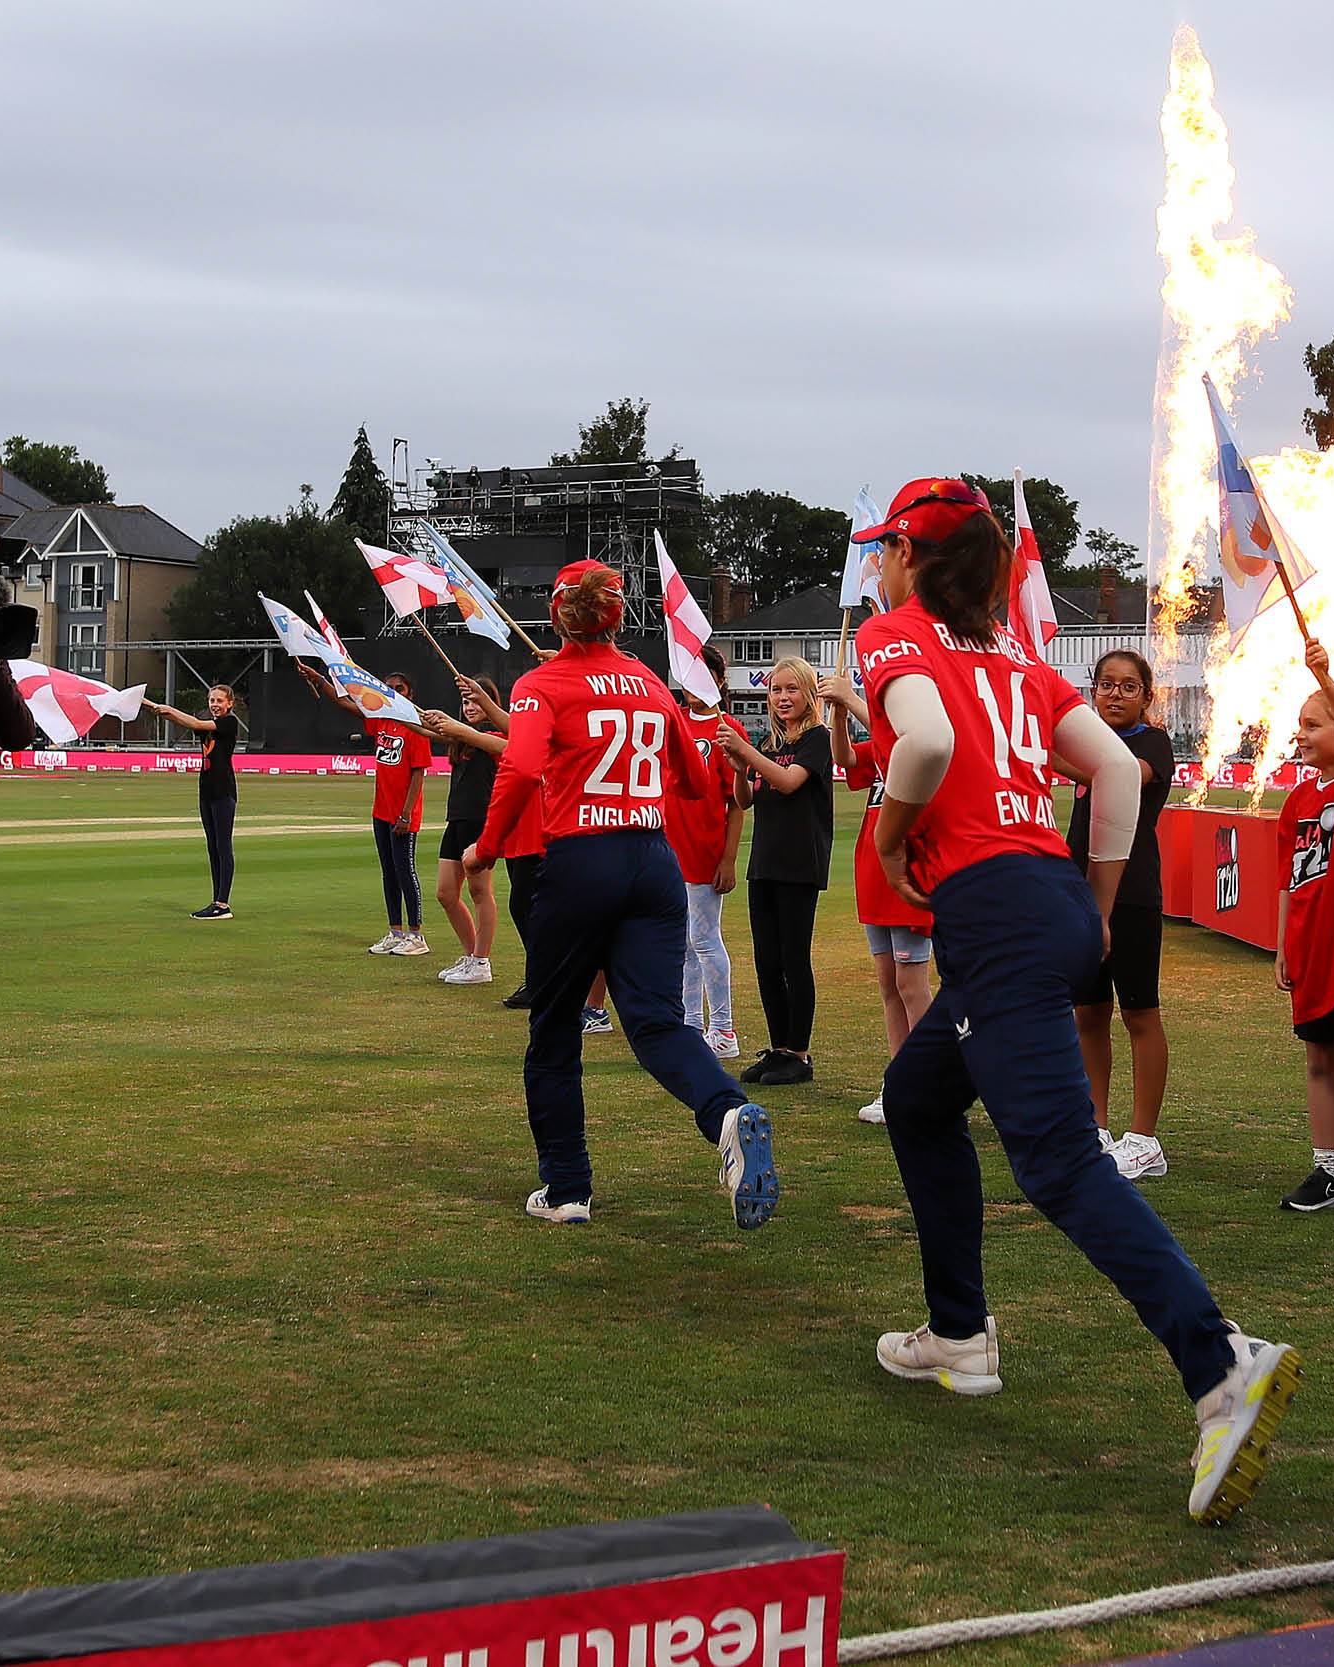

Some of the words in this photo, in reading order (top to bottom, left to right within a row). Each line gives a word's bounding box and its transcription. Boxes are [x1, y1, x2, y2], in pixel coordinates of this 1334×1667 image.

[898, 519, 909, 530] 52
[585, 673, 649, 697] WYATT
[974, 666, 1048, 785] 14
[583, 709, 665, 798] 28
[578, 804, 662, 830] ENGLAND
